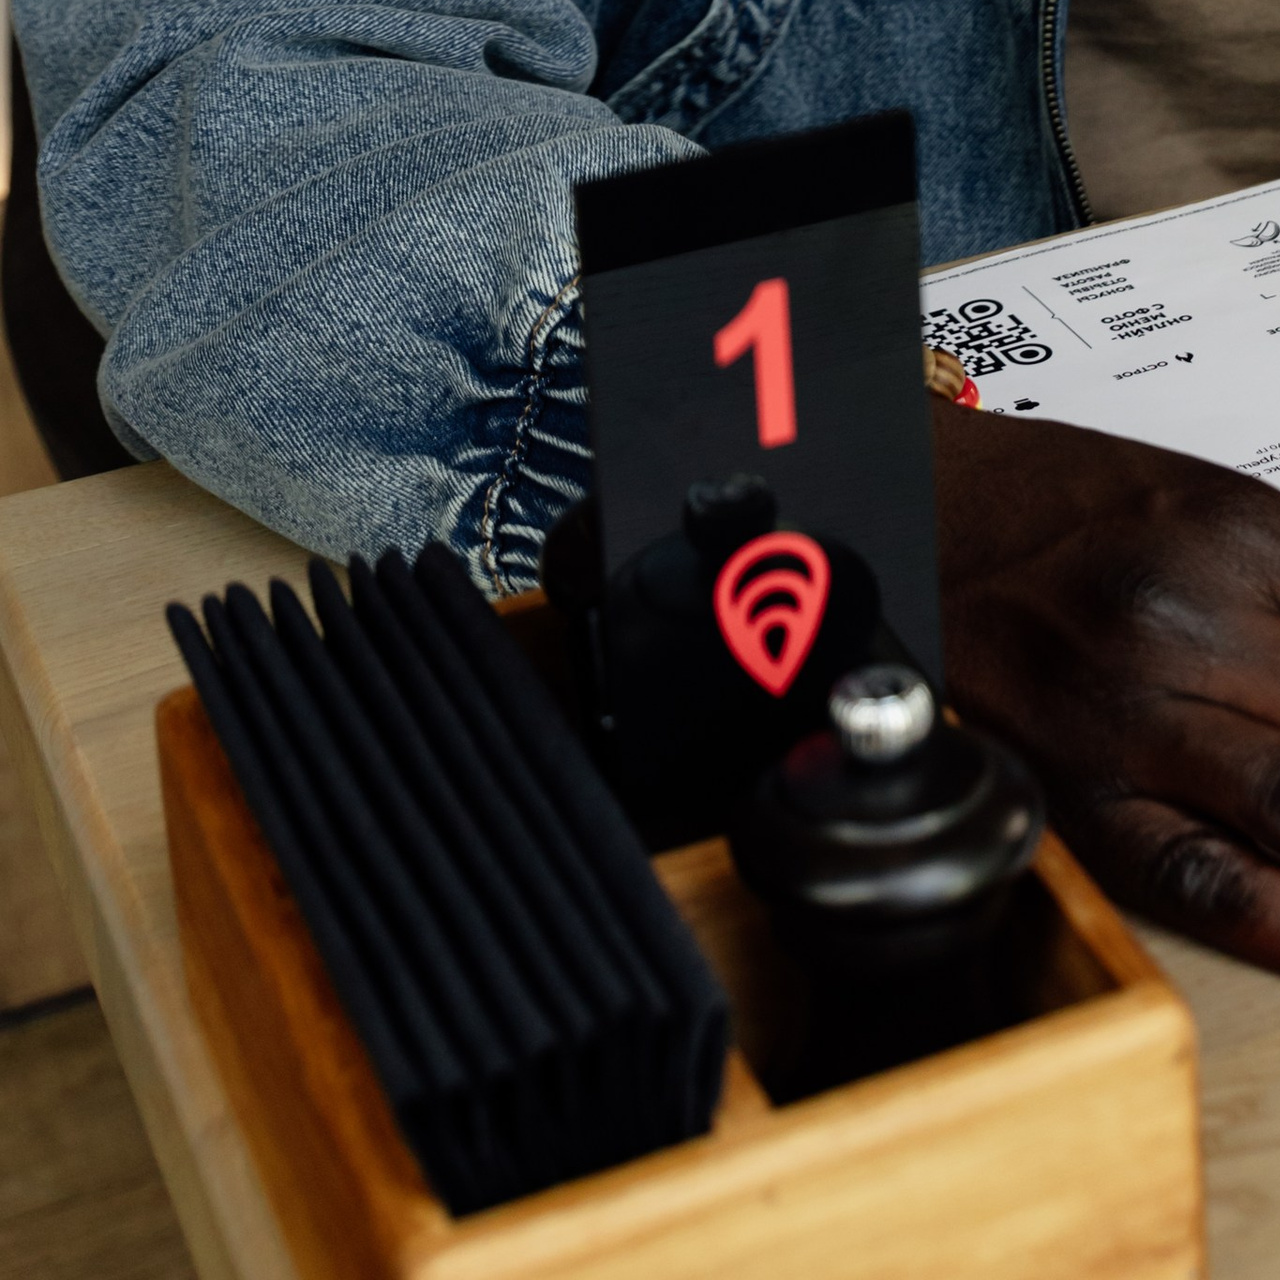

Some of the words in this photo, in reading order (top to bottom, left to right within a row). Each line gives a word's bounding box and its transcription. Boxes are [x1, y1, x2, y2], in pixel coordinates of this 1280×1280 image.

[1050, 258, 1130, 281] ФРАНШИЗА
[1059, 271, 1112, 288] РАБОТА
[1067, 276, 1127, 295] ОТЗЫВЫ
[1075, 283, 1134, 303] БОНУСЫ
[1099, 307, 1150, 324] ФОТО
[1150, 302, 1164, 310] С
[1108, 311, 1166, 331] МЕНЮ
[1110, 314, 1192, 340] ОНЛАЙН-
[713, 277, 798, 449] 1
[1111, 360, 1168, 380] ОСТРОЕ
